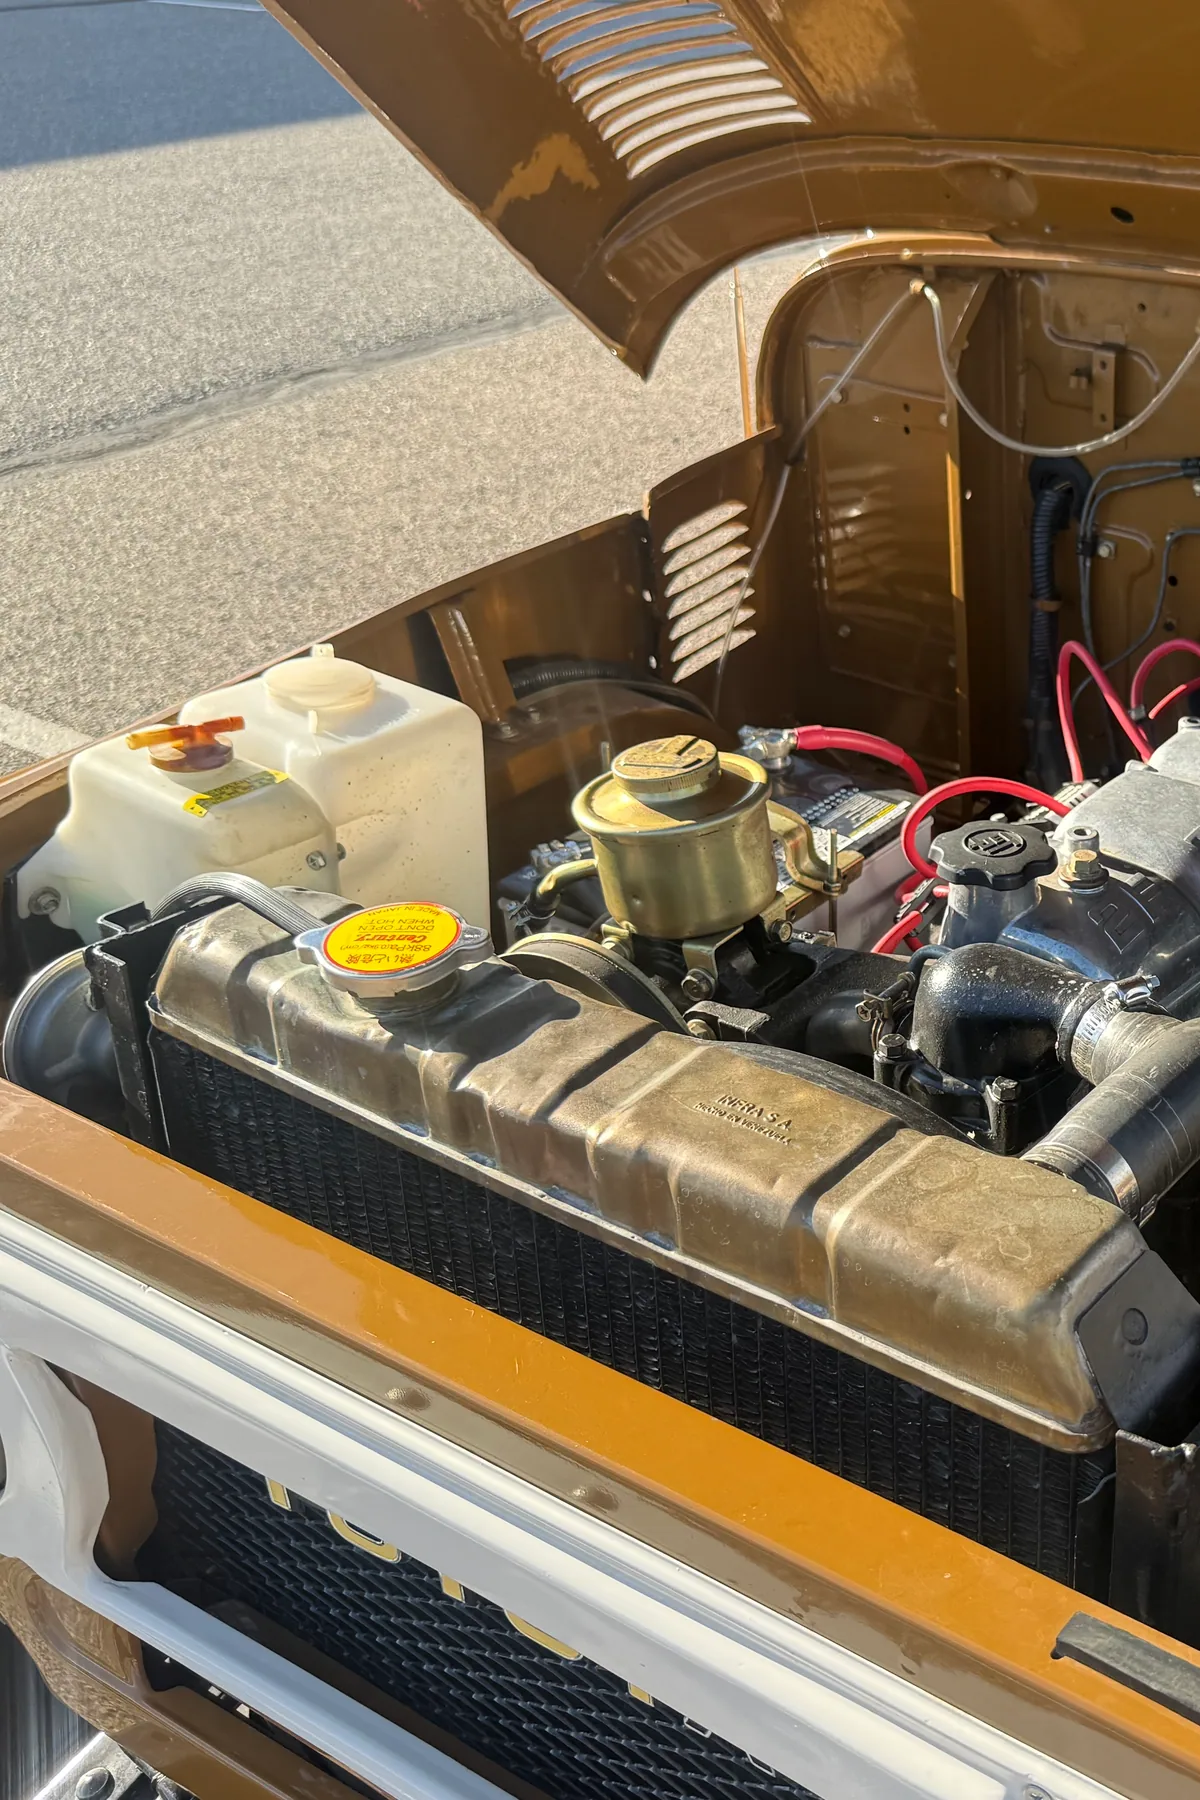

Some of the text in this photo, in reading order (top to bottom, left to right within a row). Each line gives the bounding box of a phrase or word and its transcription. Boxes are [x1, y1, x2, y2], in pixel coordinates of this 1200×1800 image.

[368, 906, 401, 917] JAPAN
[416, 906, 442, 917] MADE
[353, 933, 428, 943] Century
[345, 953, 415, 964] 熱いと危険
[693, 1102, 727, 1118] HECHO
[715, 1094, 764, 1118] INFRA
[763, 1112, 780, 1123] S
